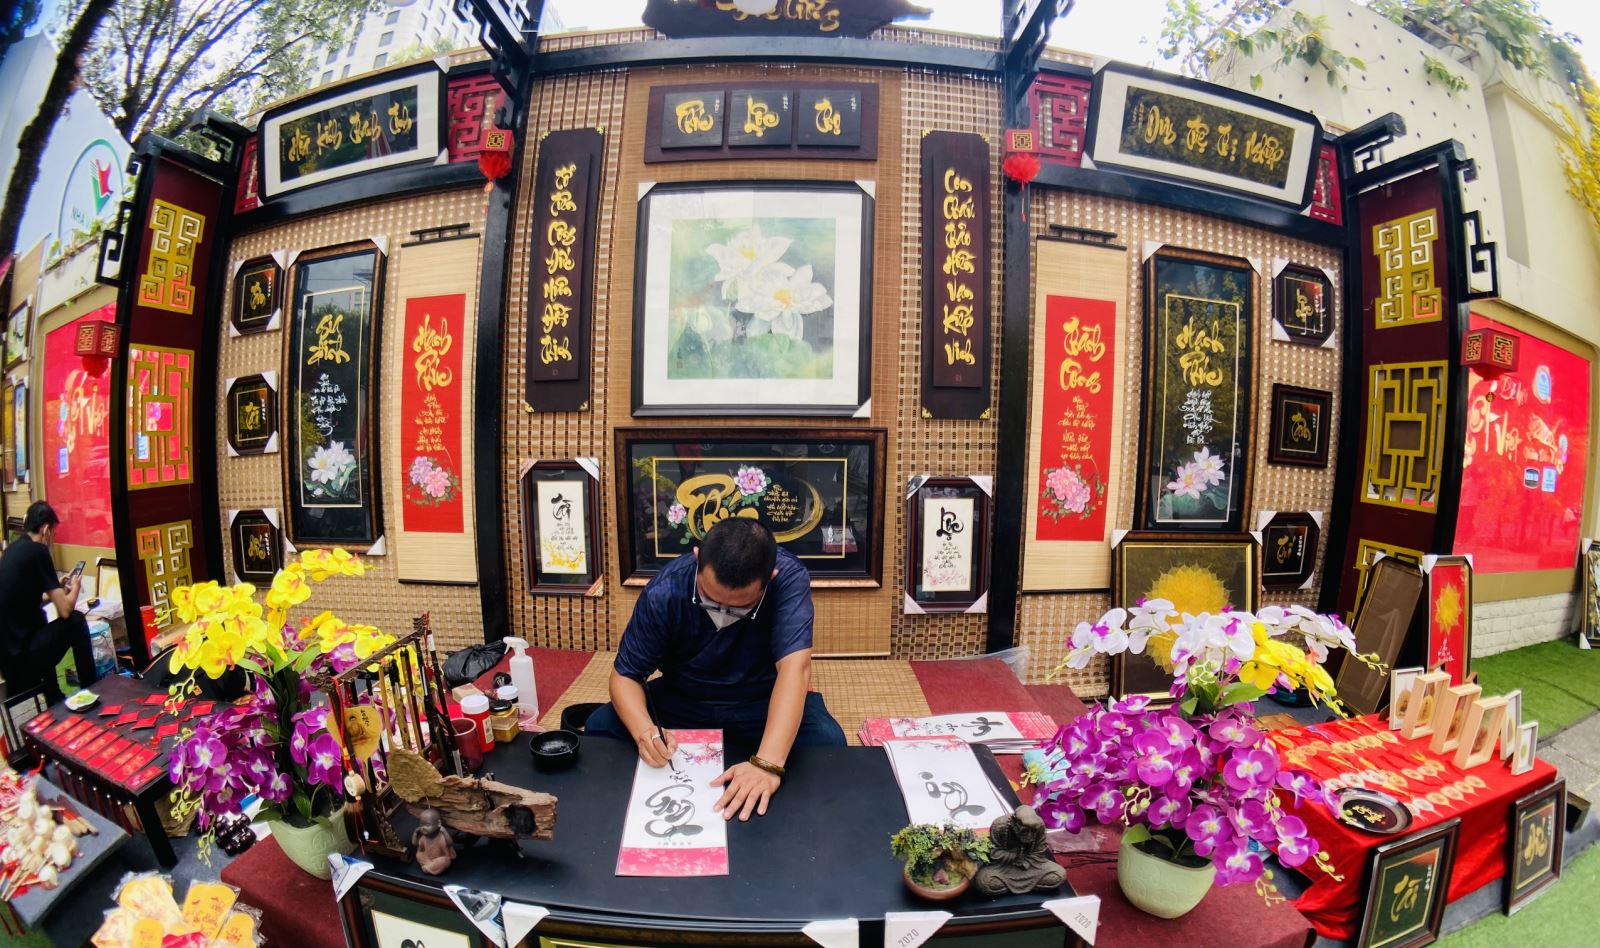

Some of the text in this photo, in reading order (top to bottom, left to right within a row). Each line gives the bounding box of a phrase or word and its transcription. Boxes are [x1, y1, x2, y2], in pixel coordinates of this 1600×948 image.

[744, 95, 780, 137] Lộc
[814, 98, 841, 135] Thọ
[943, 168, 976, 366] Con Cháu Thảo Hiền Vạn Kiếp Vinh
[1063, 317, 1105, 362] Thành
[1176, 316, 1225, 353] Hạnh
[1060, 358, 1101, 394] Công
[1180, 351, 1223, 387] Phúc
[936, 506, 964, 541] Lộc
[897, 928, 920, 948] 2020
